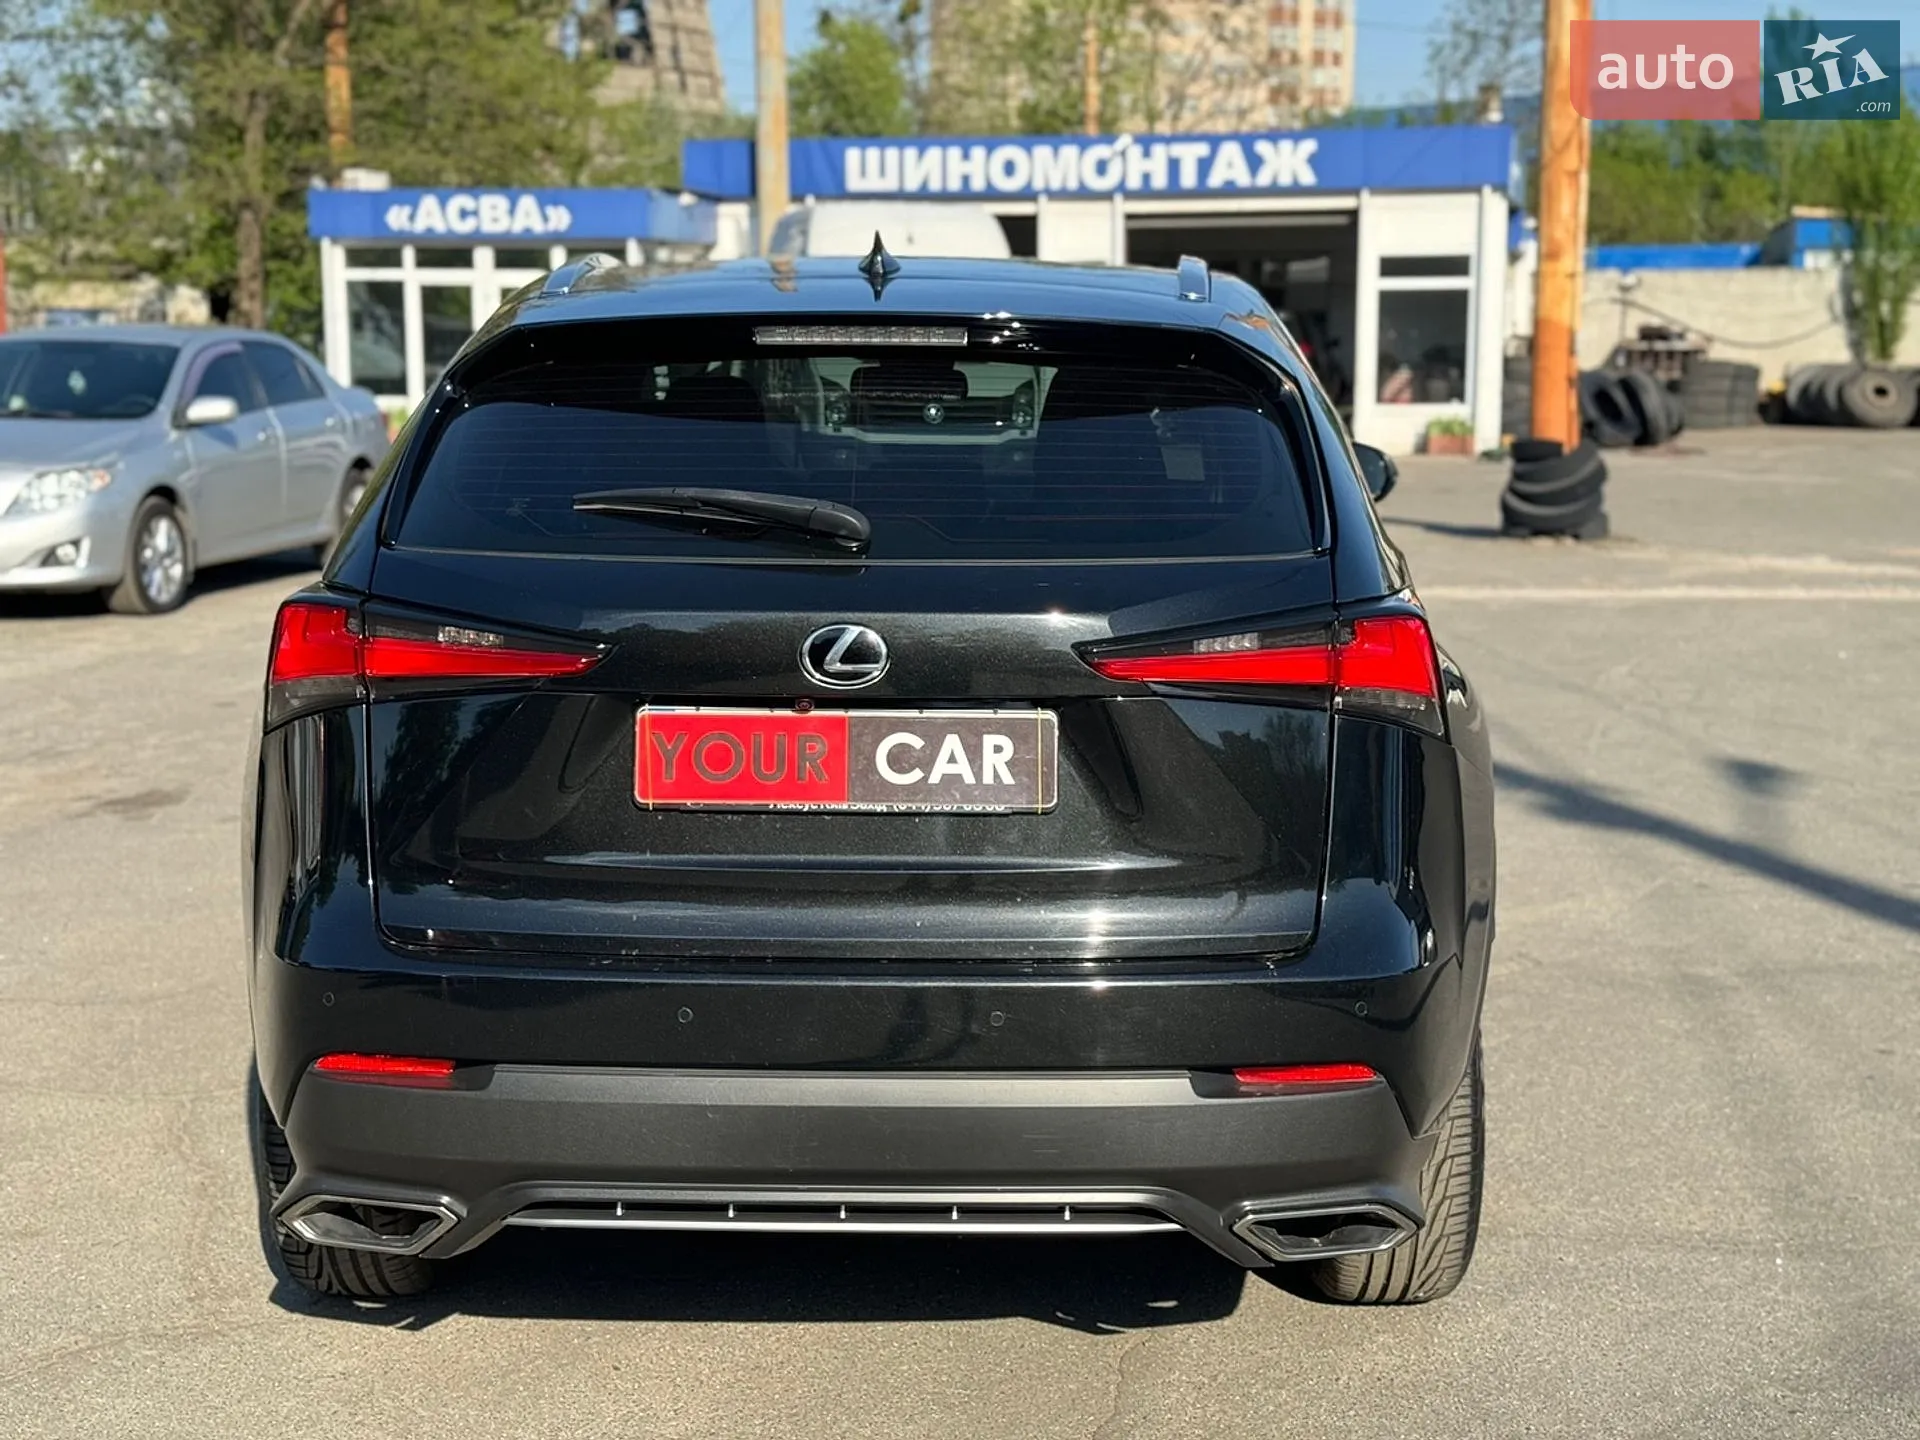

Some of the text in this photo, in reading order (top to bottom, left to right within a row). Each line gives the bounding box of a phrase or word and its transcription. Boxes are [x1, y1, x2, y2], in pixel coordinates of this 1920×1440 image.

[844, 138, 1319, 194] ШИНОМОНТАЖ
[384, 193, 573, 235] «АСВА»
[651, 731, 1017, 785] YOUR CAR
